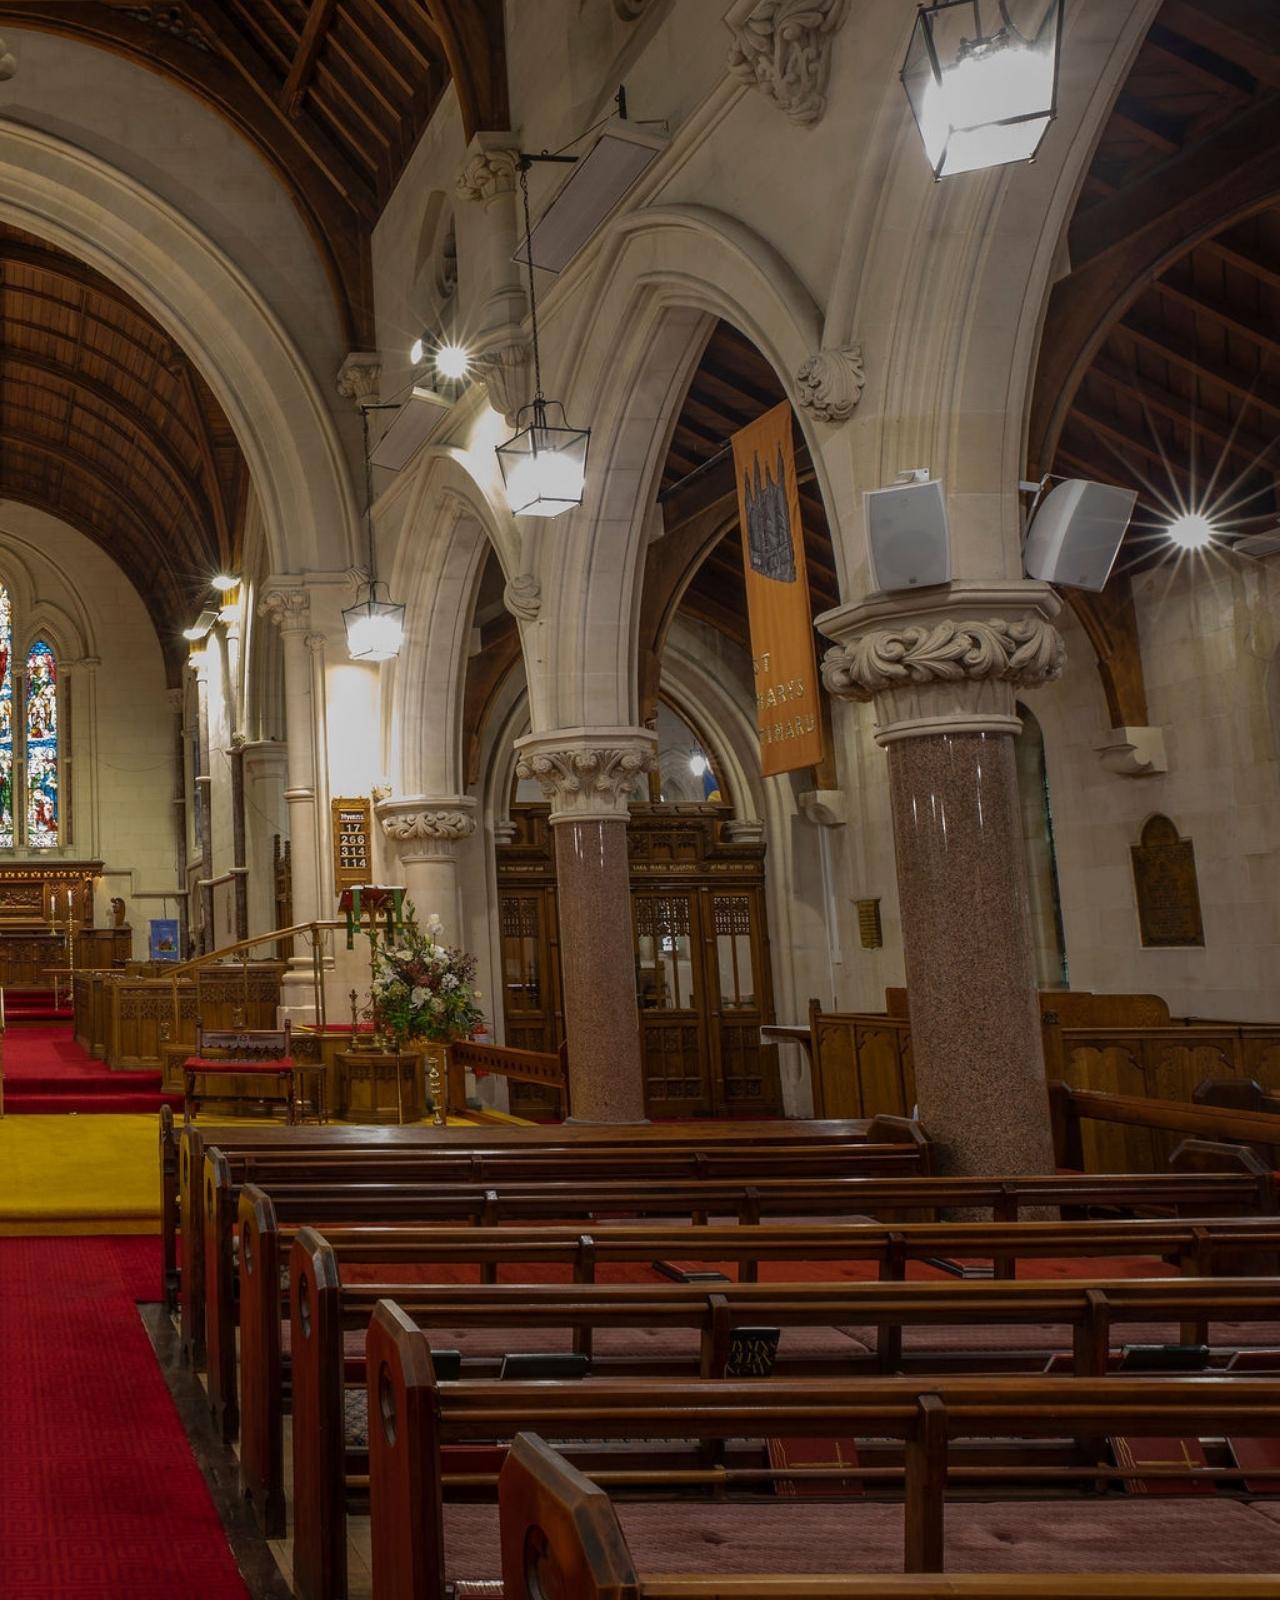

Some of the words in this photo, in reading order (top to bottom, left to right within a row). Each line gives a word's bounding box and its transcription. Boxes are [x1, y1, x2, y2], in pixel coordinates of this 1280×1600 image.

[346, 823, 361, 833] 17
[341, 835, 365, 845] 266
[341, 847, 365, 857] 314
[343, 859, 366, 868] 114
